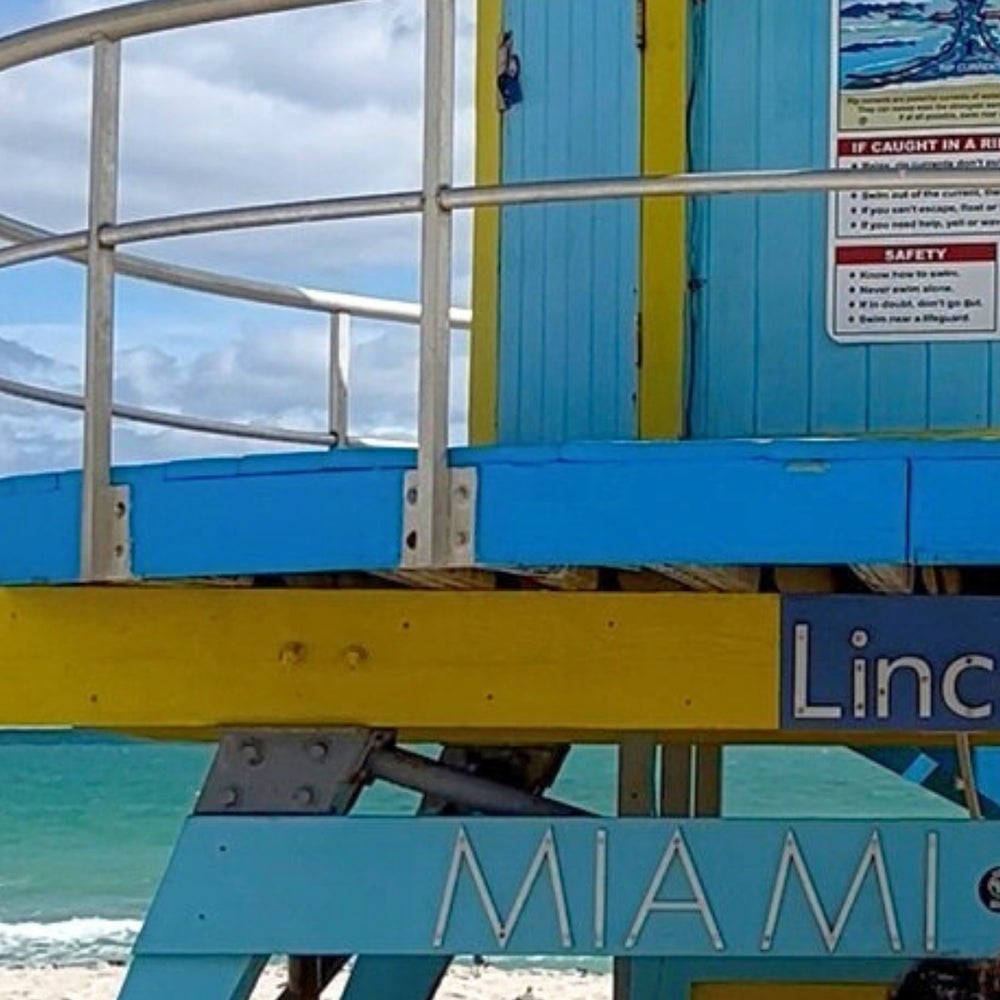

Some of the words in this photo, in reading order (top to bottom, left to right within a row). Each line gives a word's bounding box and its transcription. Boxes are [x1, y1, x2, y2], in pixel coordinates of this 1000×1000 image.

[851, 141, 864, 153] IF
[871, 139, 938, 154] CAUGHT
[942, 138, 960, 150] IN
[963, 138, 976, 150] A
[884, 248, 947, 262] SAFETY
[431, 825, 939, 954] MIAMI
